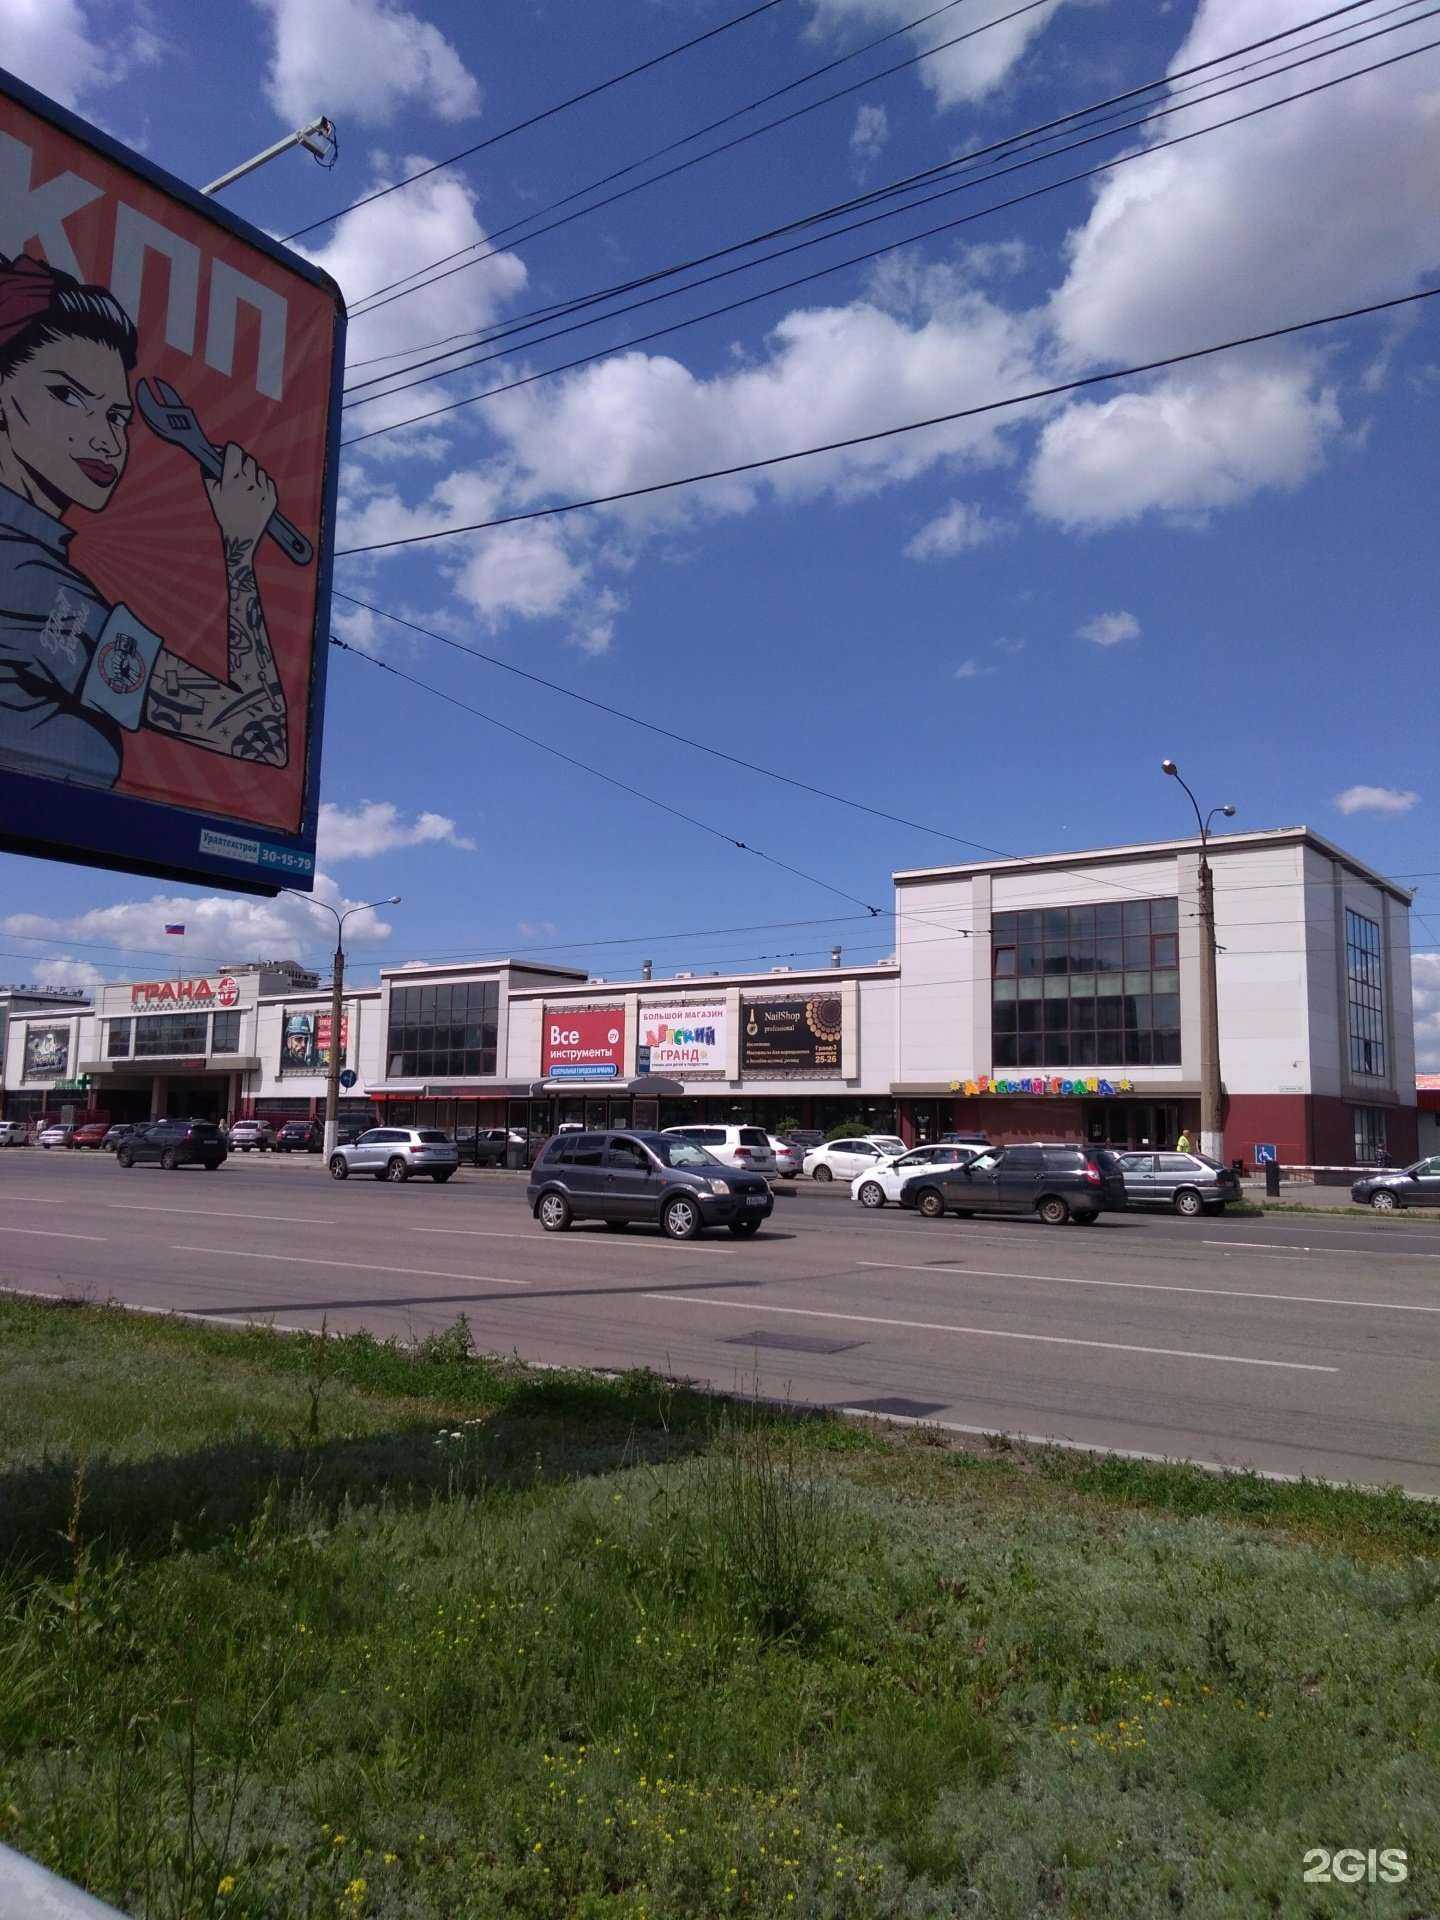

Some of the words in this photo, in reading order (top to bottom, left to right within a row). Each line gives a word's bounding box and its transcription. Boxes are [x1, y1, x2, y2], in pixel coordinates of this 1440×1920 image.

[261, 848, 312, 870] 30-15-79
[131, 978, 216, 1003] ГРАНД
[643, 1011, 683, 1021] БОЛЬШОЙ
[684, 1009, 723, 1019] МАГАЗИН
[764, 1011, 800, 1023] NailShop
[550, 1025, 580, 1046] Все
[550, 1048, 613, 1061] инструменты
[660, 1048, 700, 1062] ГРАНД
[815, 1055, 837, 1064] 25-26
